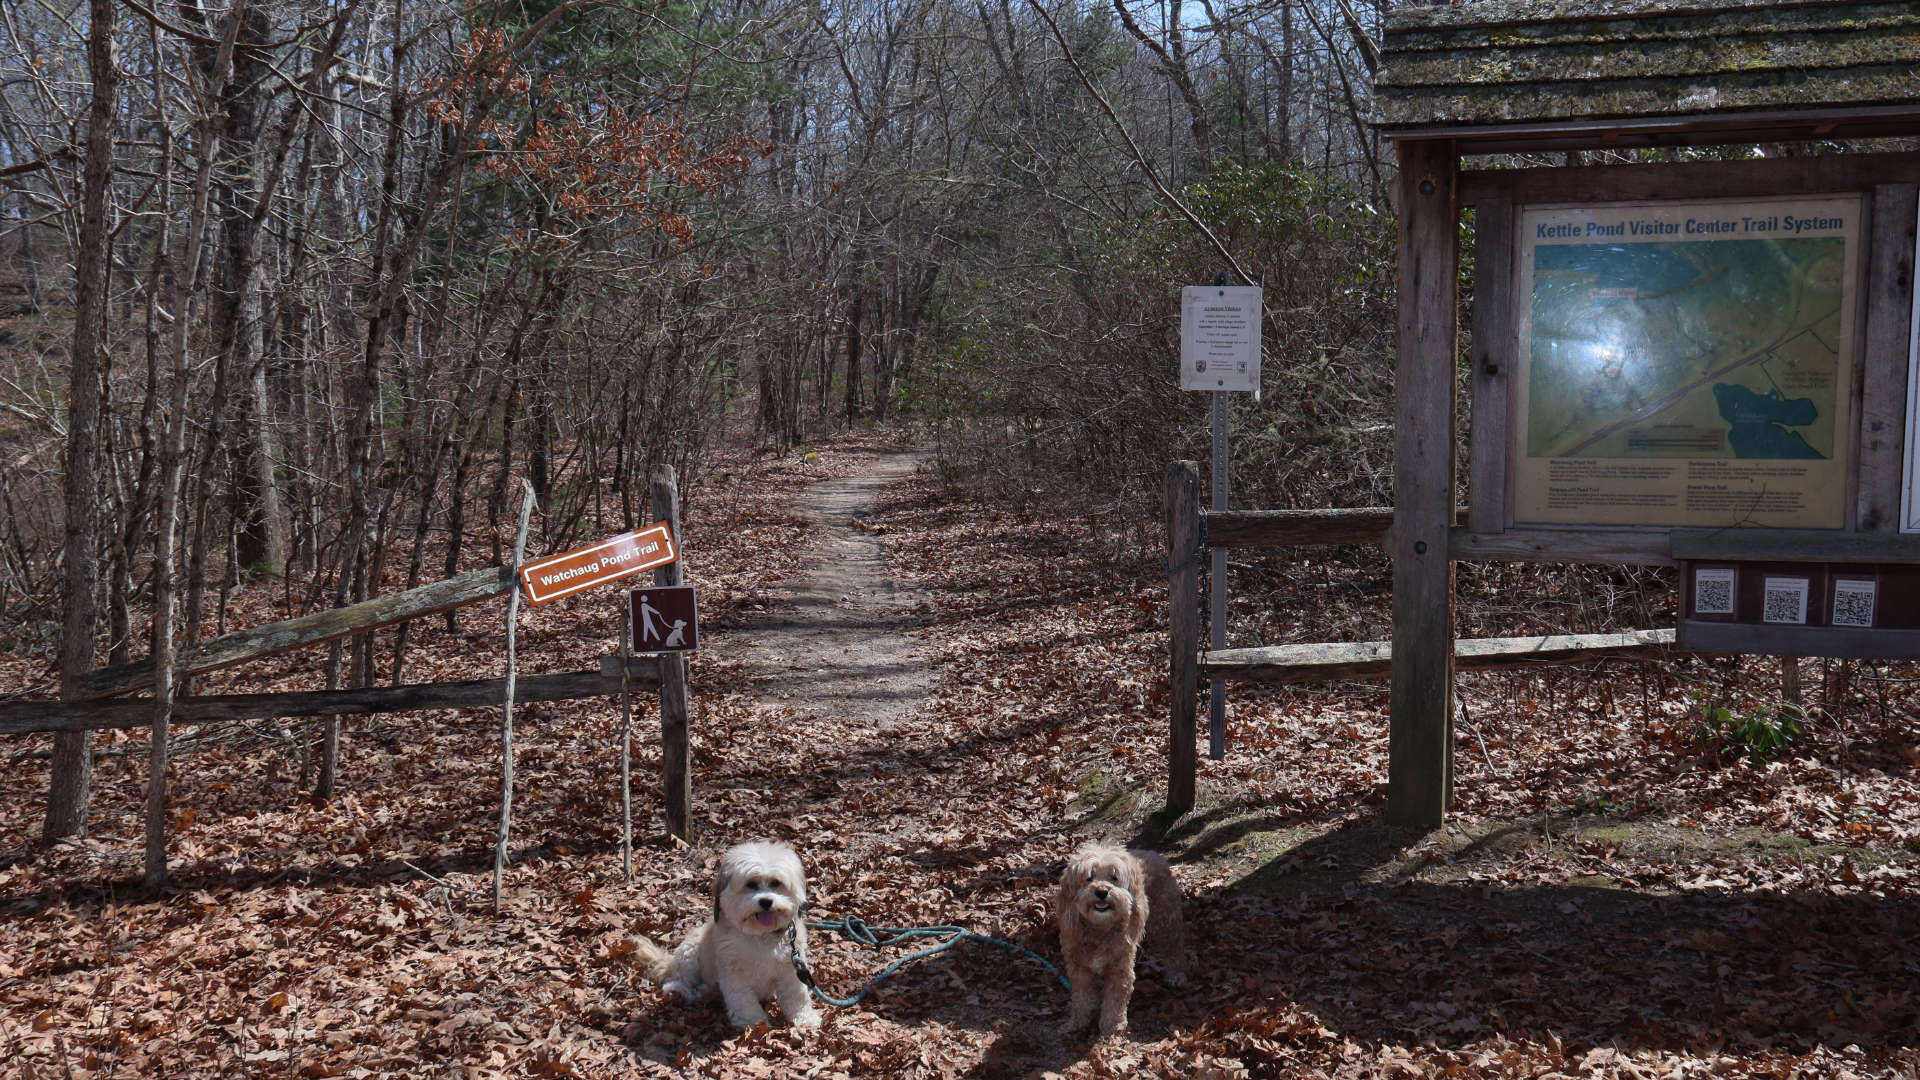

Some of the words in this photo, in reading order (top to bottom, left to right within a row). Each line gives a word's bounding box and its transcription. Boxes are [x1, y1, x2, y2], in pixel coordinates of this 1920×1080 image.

[1537, 222, 1581, 238] Kettle
[1587, 221, 1625, 237] Pond
[1630, 219, 1681, 236] Visitor
[1686, 218, 1738, 235] Center
[1742, 217, 1778, 232] Trail
[1783, 215, 1844, 233] System
[540, 562, 600, 586] Watchaug
[601, 551, 631, 567] Pond
[633, 541, 659, 557] Trail
